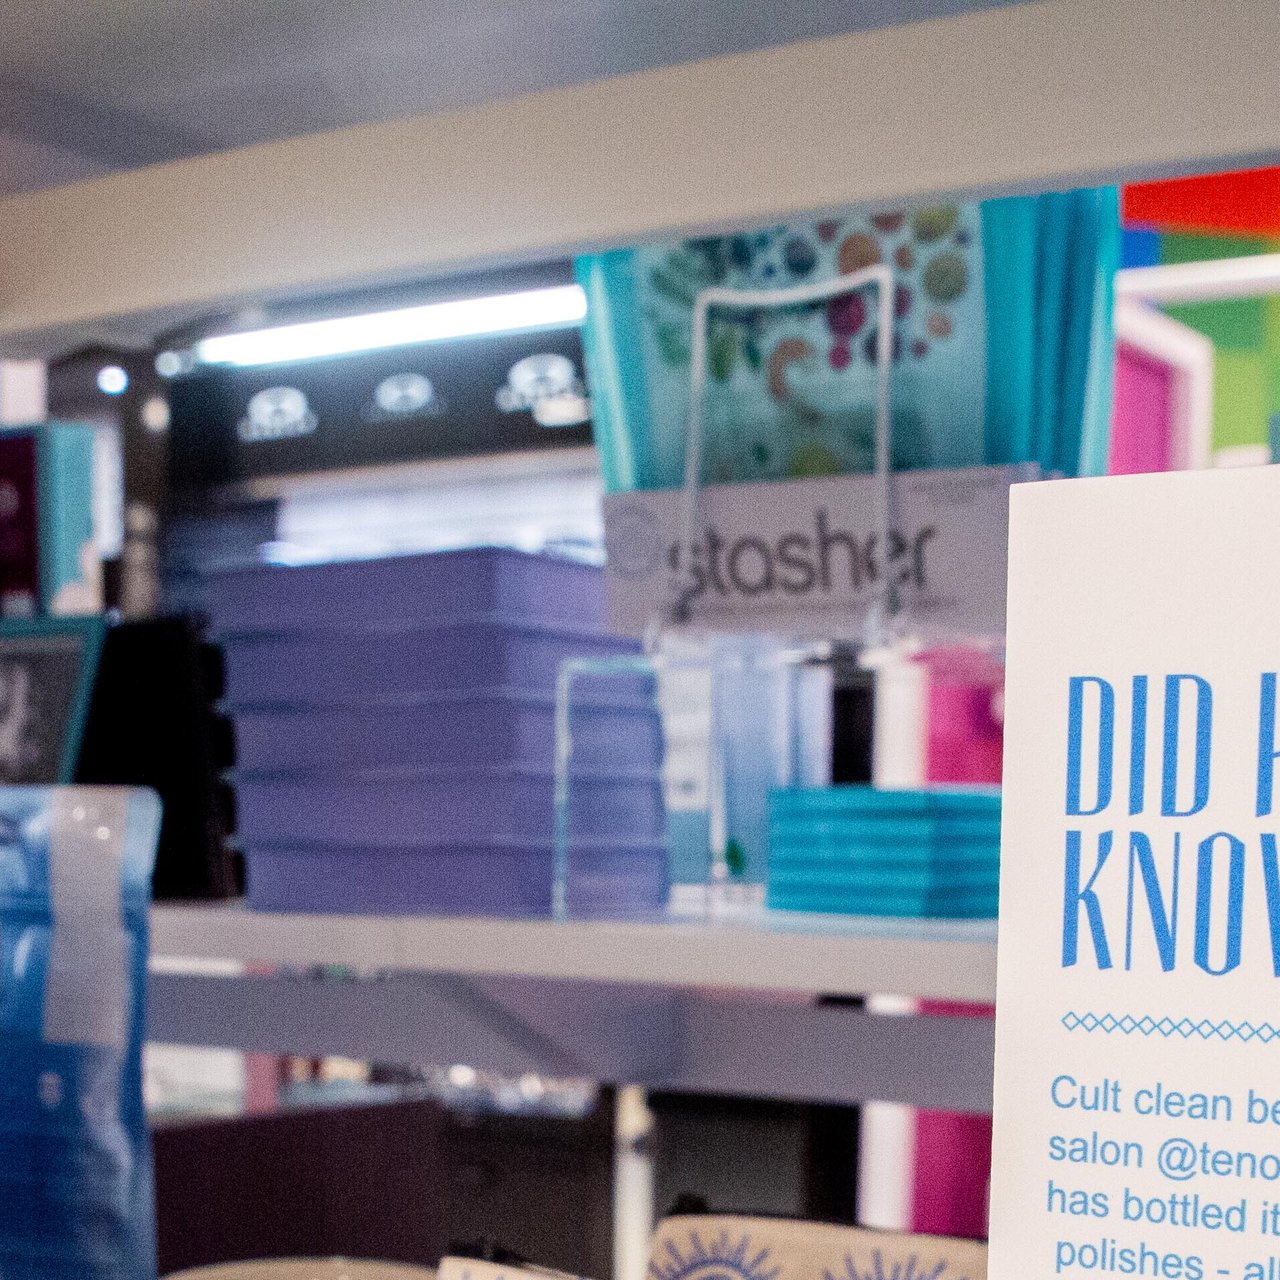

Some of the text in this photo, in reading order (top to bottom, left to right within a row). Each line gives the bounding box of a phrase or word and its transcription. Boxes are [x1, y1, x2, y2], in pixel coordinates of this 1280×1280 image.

[668, 508, 936, 597] stasher
[1066, 674, 1213, 816] DID
[1051, 1075, 1120, 1113] Cult
[1133, 1083, 1232, 1120] clean
[1049, 1132, 1143, 1167] salon
[1047, 1181, 1109, 1218] has
[1123, 1188, 1247, 1232] bottled
[1056, 1239, 1204, 1280] polishes
